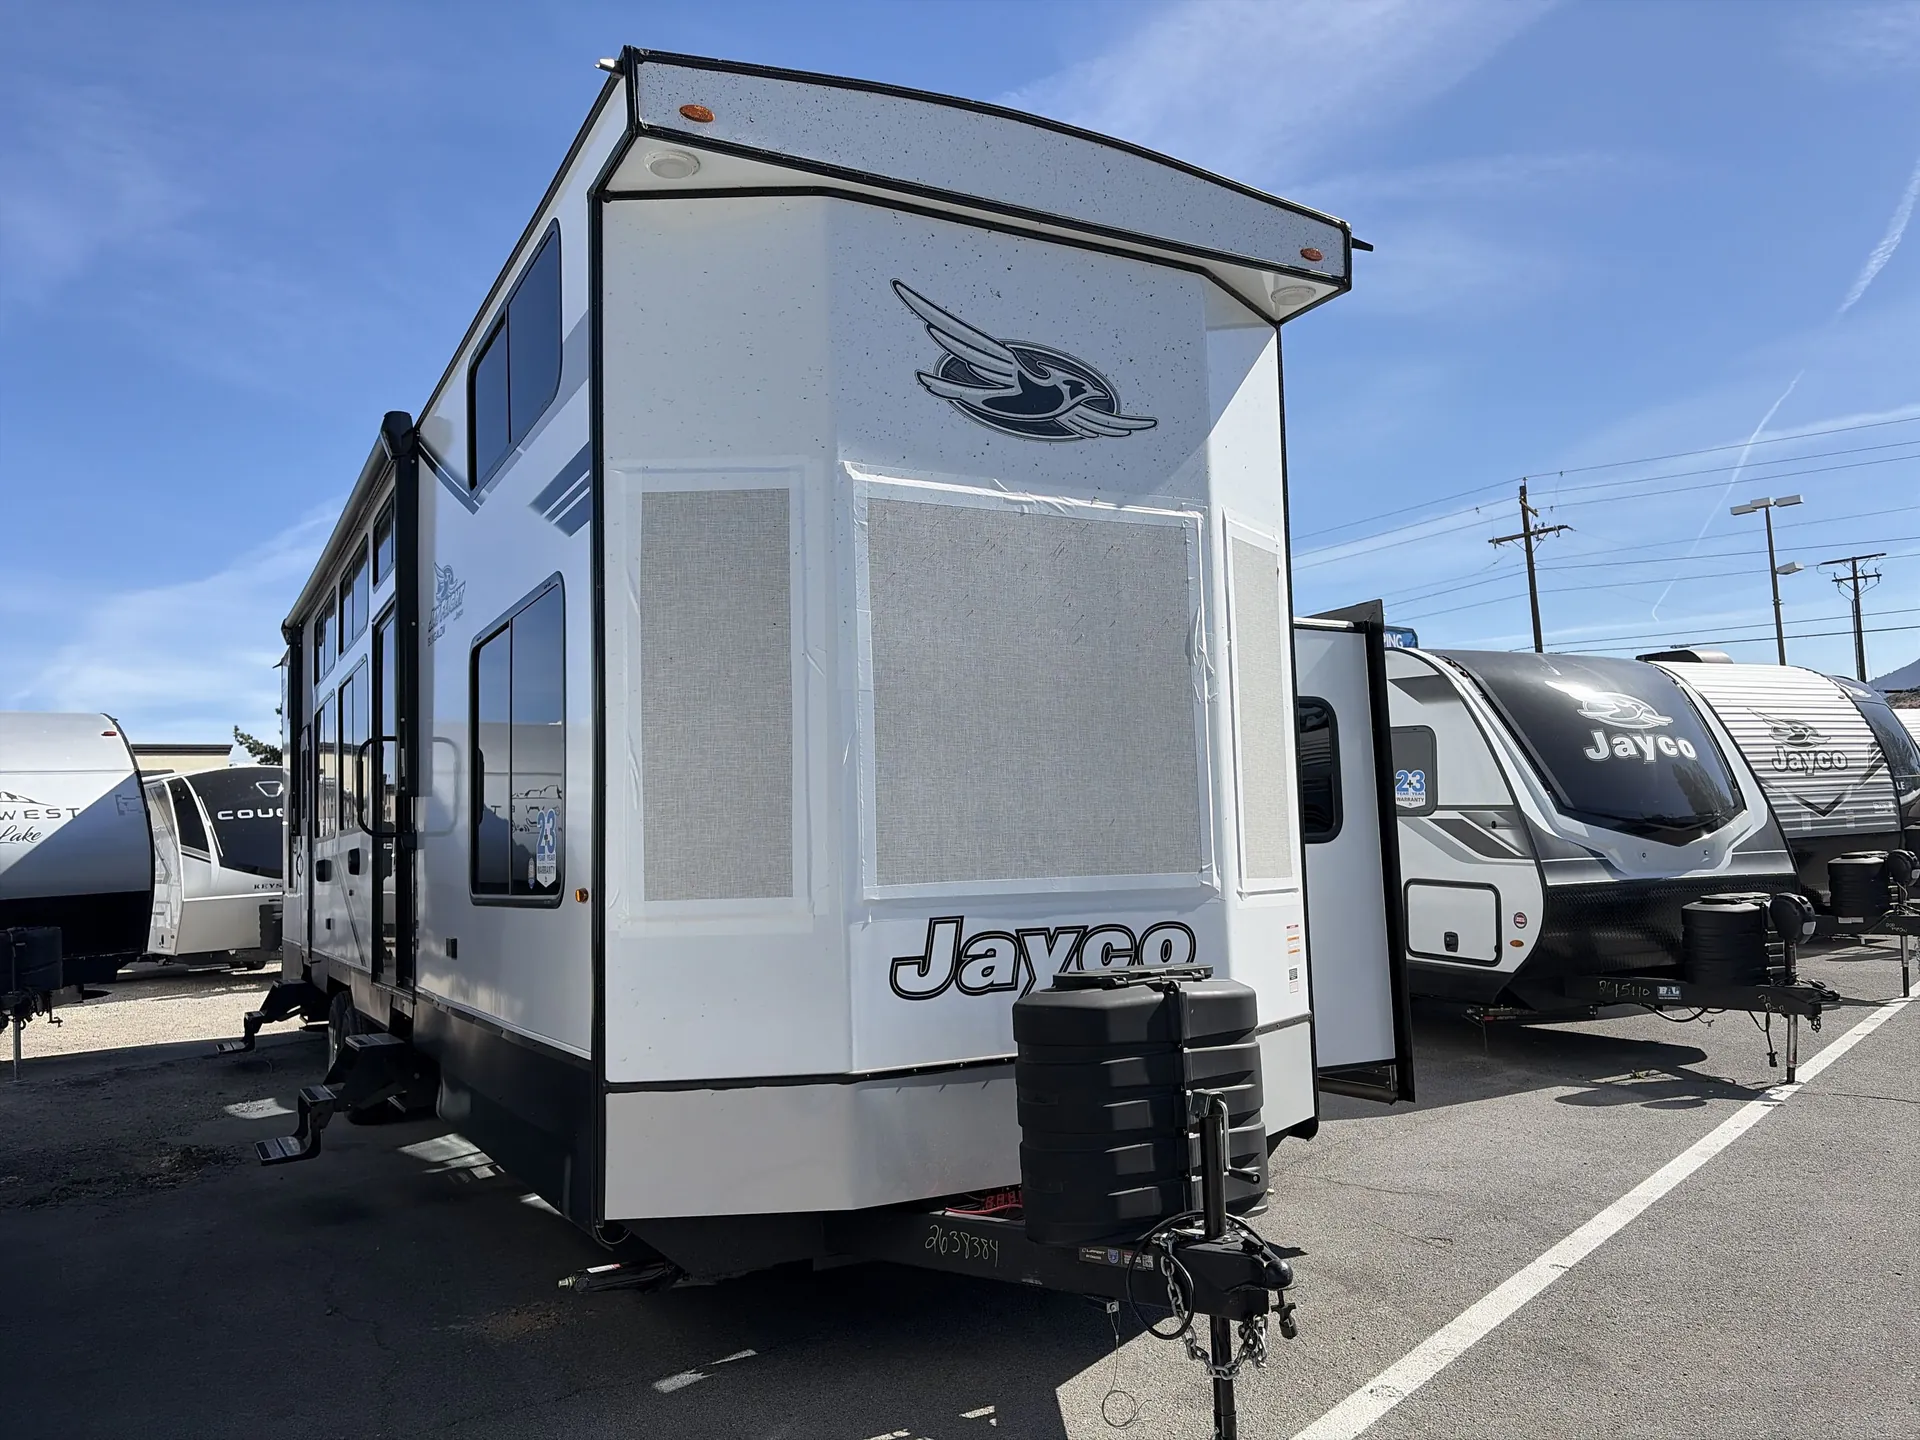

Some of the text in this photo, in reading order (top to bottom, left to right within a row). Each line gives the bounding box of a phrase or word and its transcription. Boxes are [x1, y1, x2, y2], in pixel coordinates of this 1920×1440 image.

[1583, 728, 1698, 764] Jayco
[1772, 746, 1848, 776] Jayco
[889, 914, 1197, 1001] Jayco
[925, 1224, 999, 1268] 2638384
